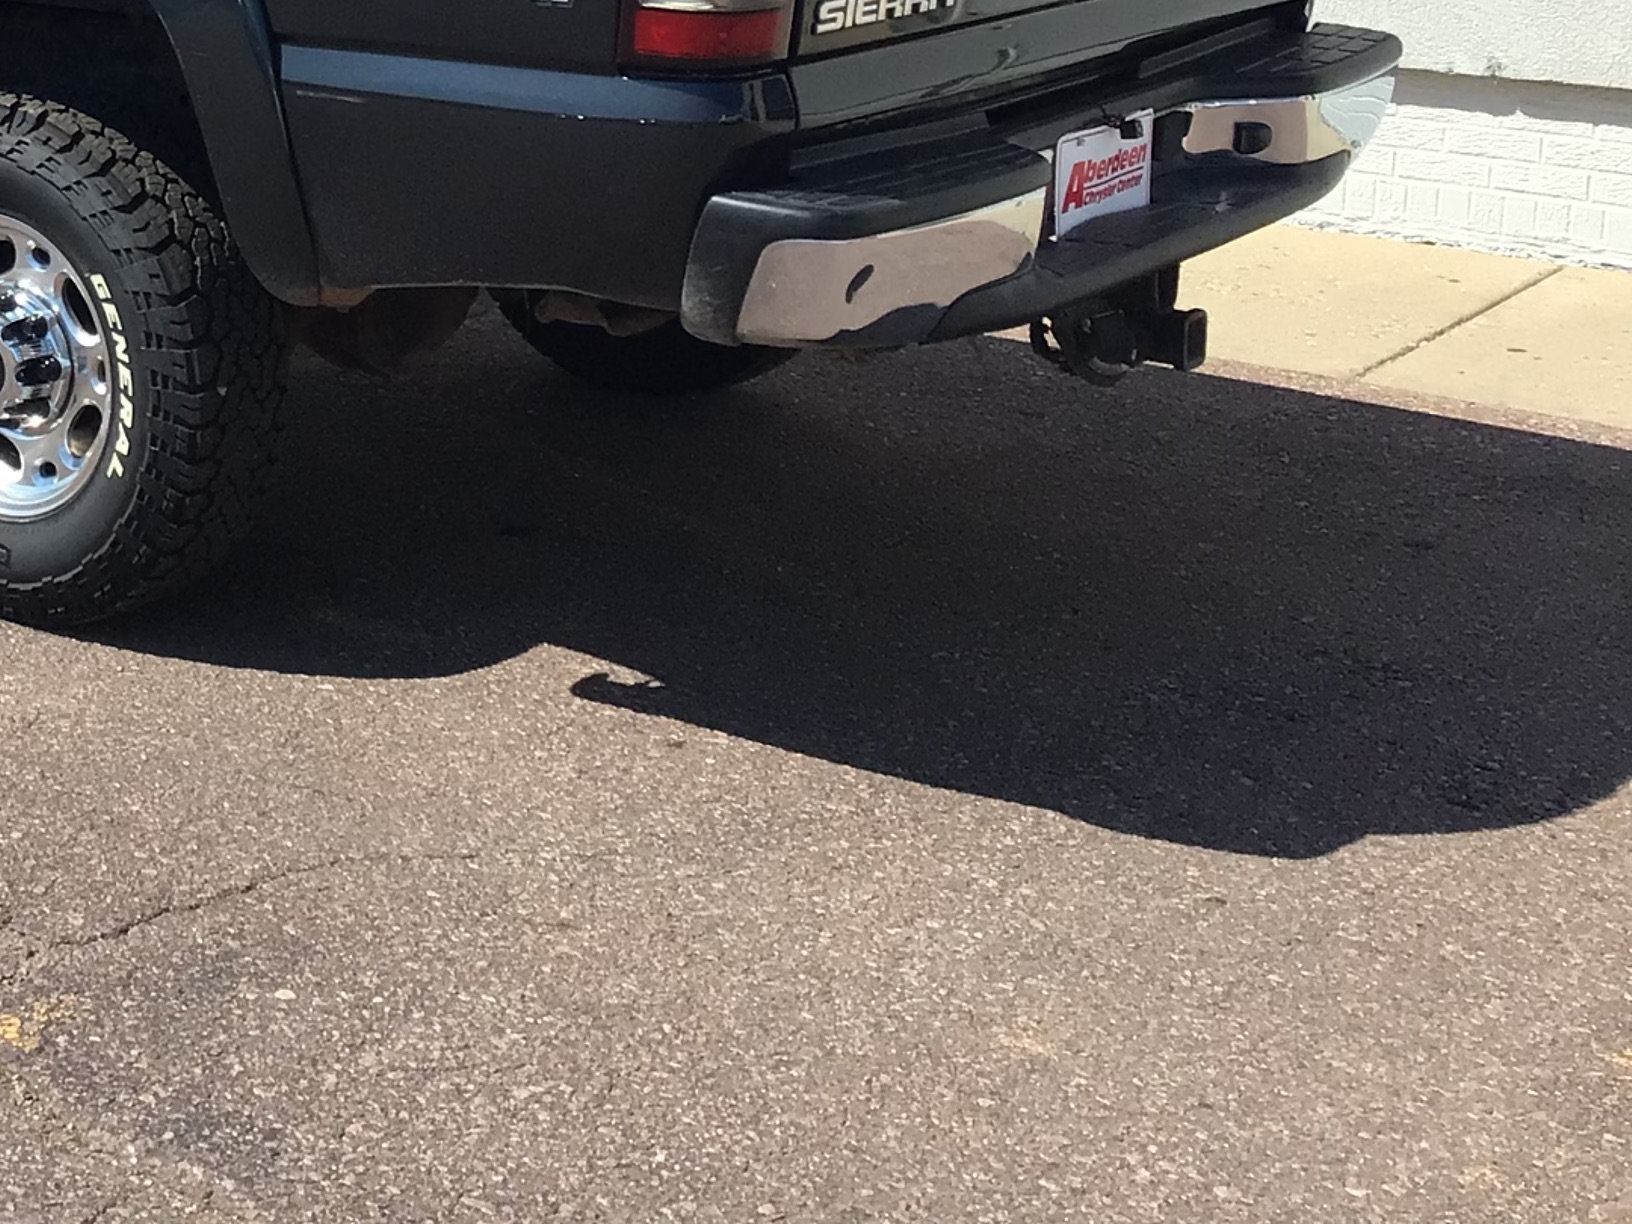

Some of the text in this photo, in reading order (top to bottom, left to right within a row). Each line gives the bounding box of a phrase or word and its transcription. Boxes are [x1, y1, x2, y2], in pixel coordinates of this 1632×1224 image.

[1062, 144, 1146, 214] Aberdeen
[1084, 173, 1143, 205] Chrysler Center
[88, 273, 135, 479] GENERAL
